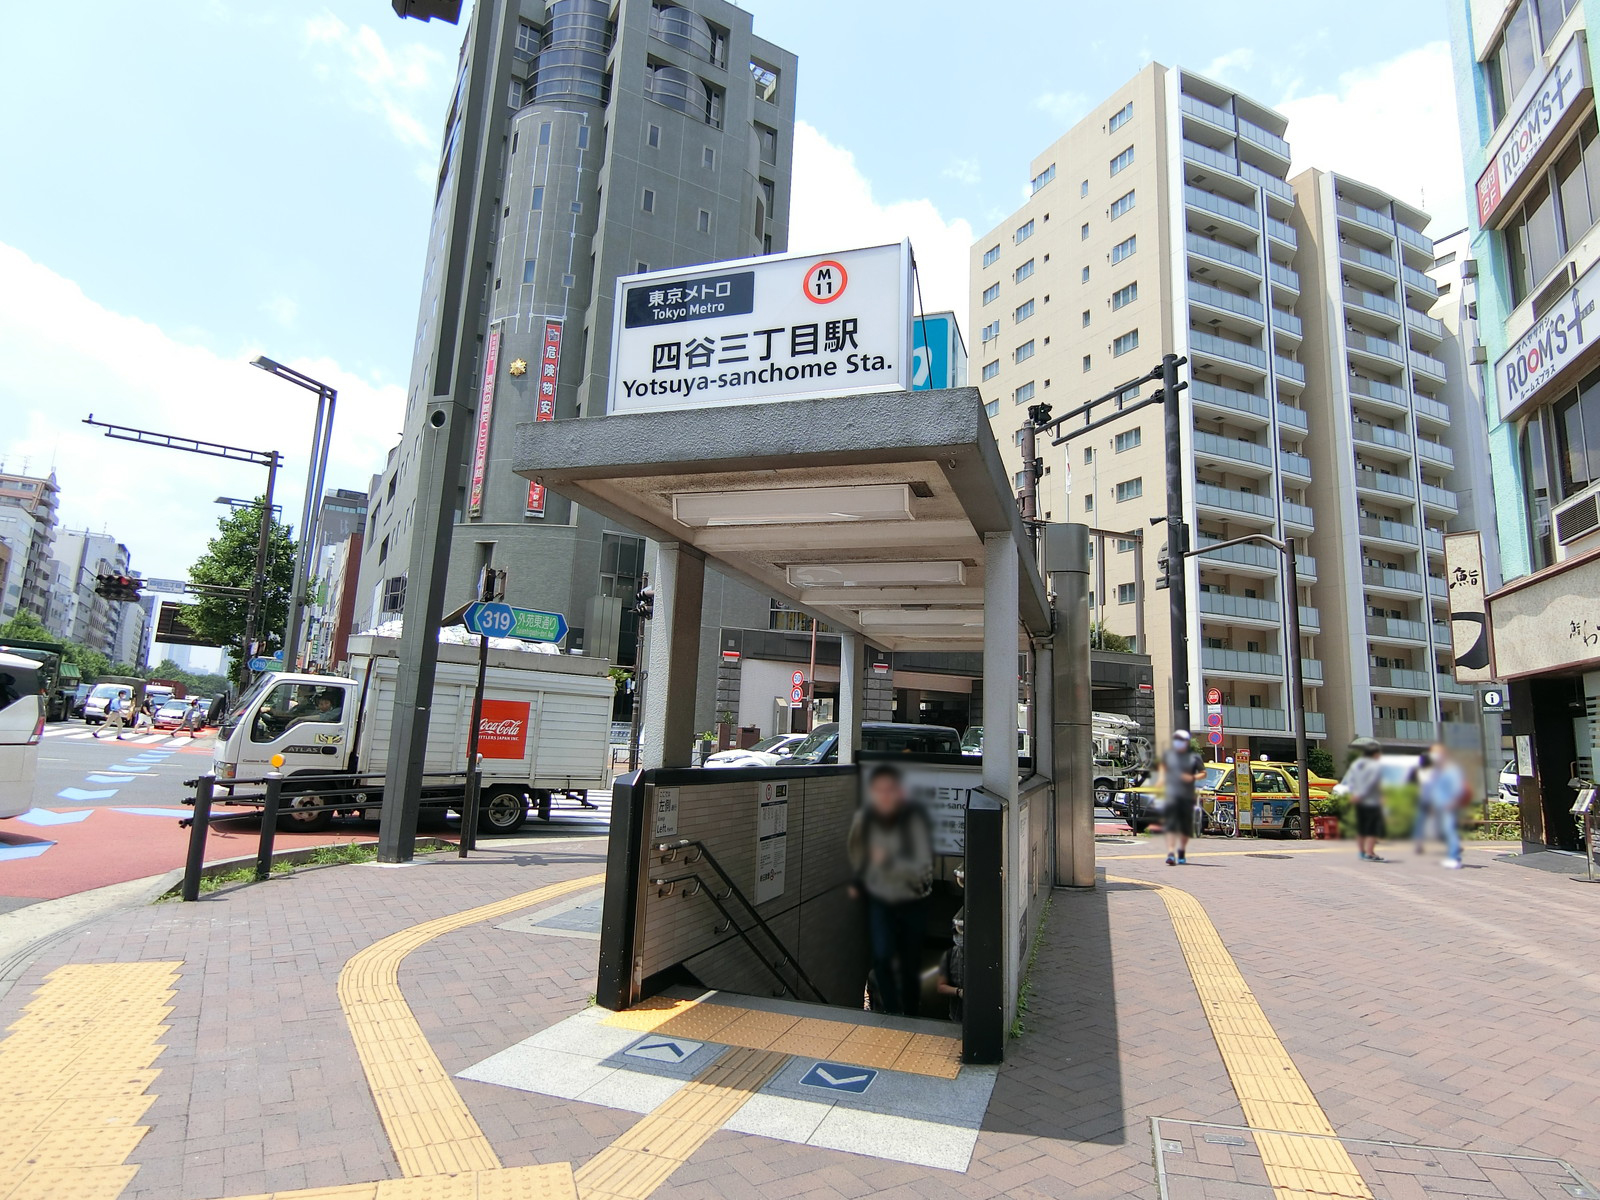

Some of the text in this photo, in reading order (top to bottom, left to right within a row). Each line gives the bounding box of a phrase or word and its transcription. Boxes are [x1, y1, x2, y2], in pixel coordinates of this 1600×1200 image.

[1483, 187, 1496, 215] 2F
[817, 269, 832, 282] M
[648, 281, 731, 307] 東京メトロ
[815, 282, 833, 296] 11
[652, 302, 725, 320] Tokyo Metro
[651, 318, 858, 373] 四谷三丁目駅
[540, 345, 557, 421] 危険物安
[622, 361, 838, 399] Yotsuya-sanchome
[846, 353, 893, 374] Sta.
[1450, 567, 1478, 589] 鮨
[482, 610, 511, 630] 319
[518, 613, 557, 630] 外苑東通り
[254, 660, 267, 668] 319
